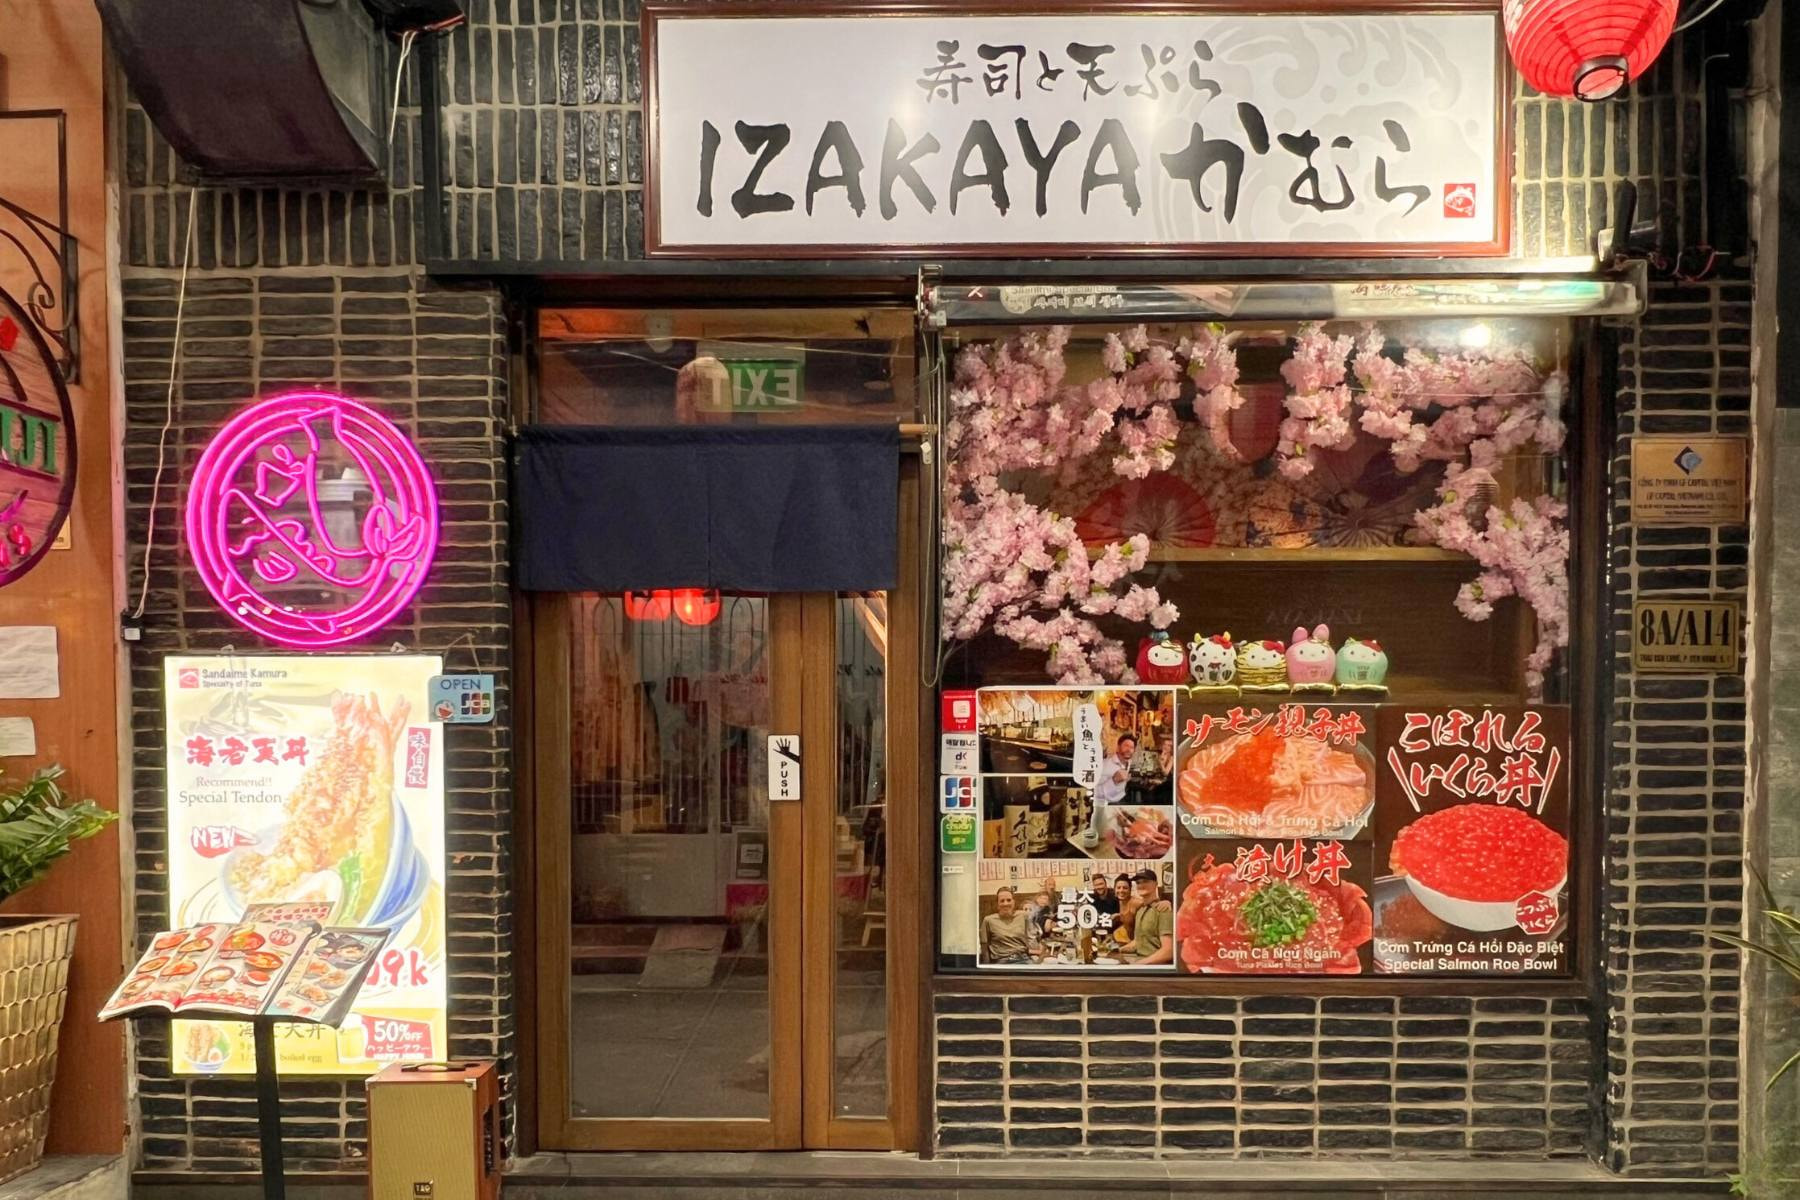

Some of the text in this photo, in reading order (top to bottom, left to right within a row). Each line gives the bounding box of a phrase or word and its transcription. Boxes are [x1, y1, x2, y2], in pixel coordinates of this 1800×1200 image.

[916, 40, 1222, 104] 寿司と天ぷら
[697, 102, 1431, 224] IZAKAYA かむら
[202, 668, 287, 678] Sandaime Kamura
[440, 678, 481, 690] OPEN
[1183, 704, 1366, 748] サーモン親子丼
[1399, 709, 1546, 753] こぼれる
[187, 735, 309, 767] 海老天丼
[781, 760, 789, 797] PUSH
[1410, 752, 1546, 807] いくら丼
[179, 790, 283, 807] Special Tendon
[190, 826, 236, 850] NEW
[1234, 838, 1352, 887] 漬け丼
[1061, 887, 1095, 903] 最大
[1379, 940, 1410, 954] Cơm
[1413, 940, 1453, 956] Trứng
[1457, 940, 1476, 954] Cá
[1507, 941, 1534, 956] Đặc
[1537, 941, 1565, 956] Biệt
[1384, 958, 1558, 973] Special Salmon Roe Bowl
